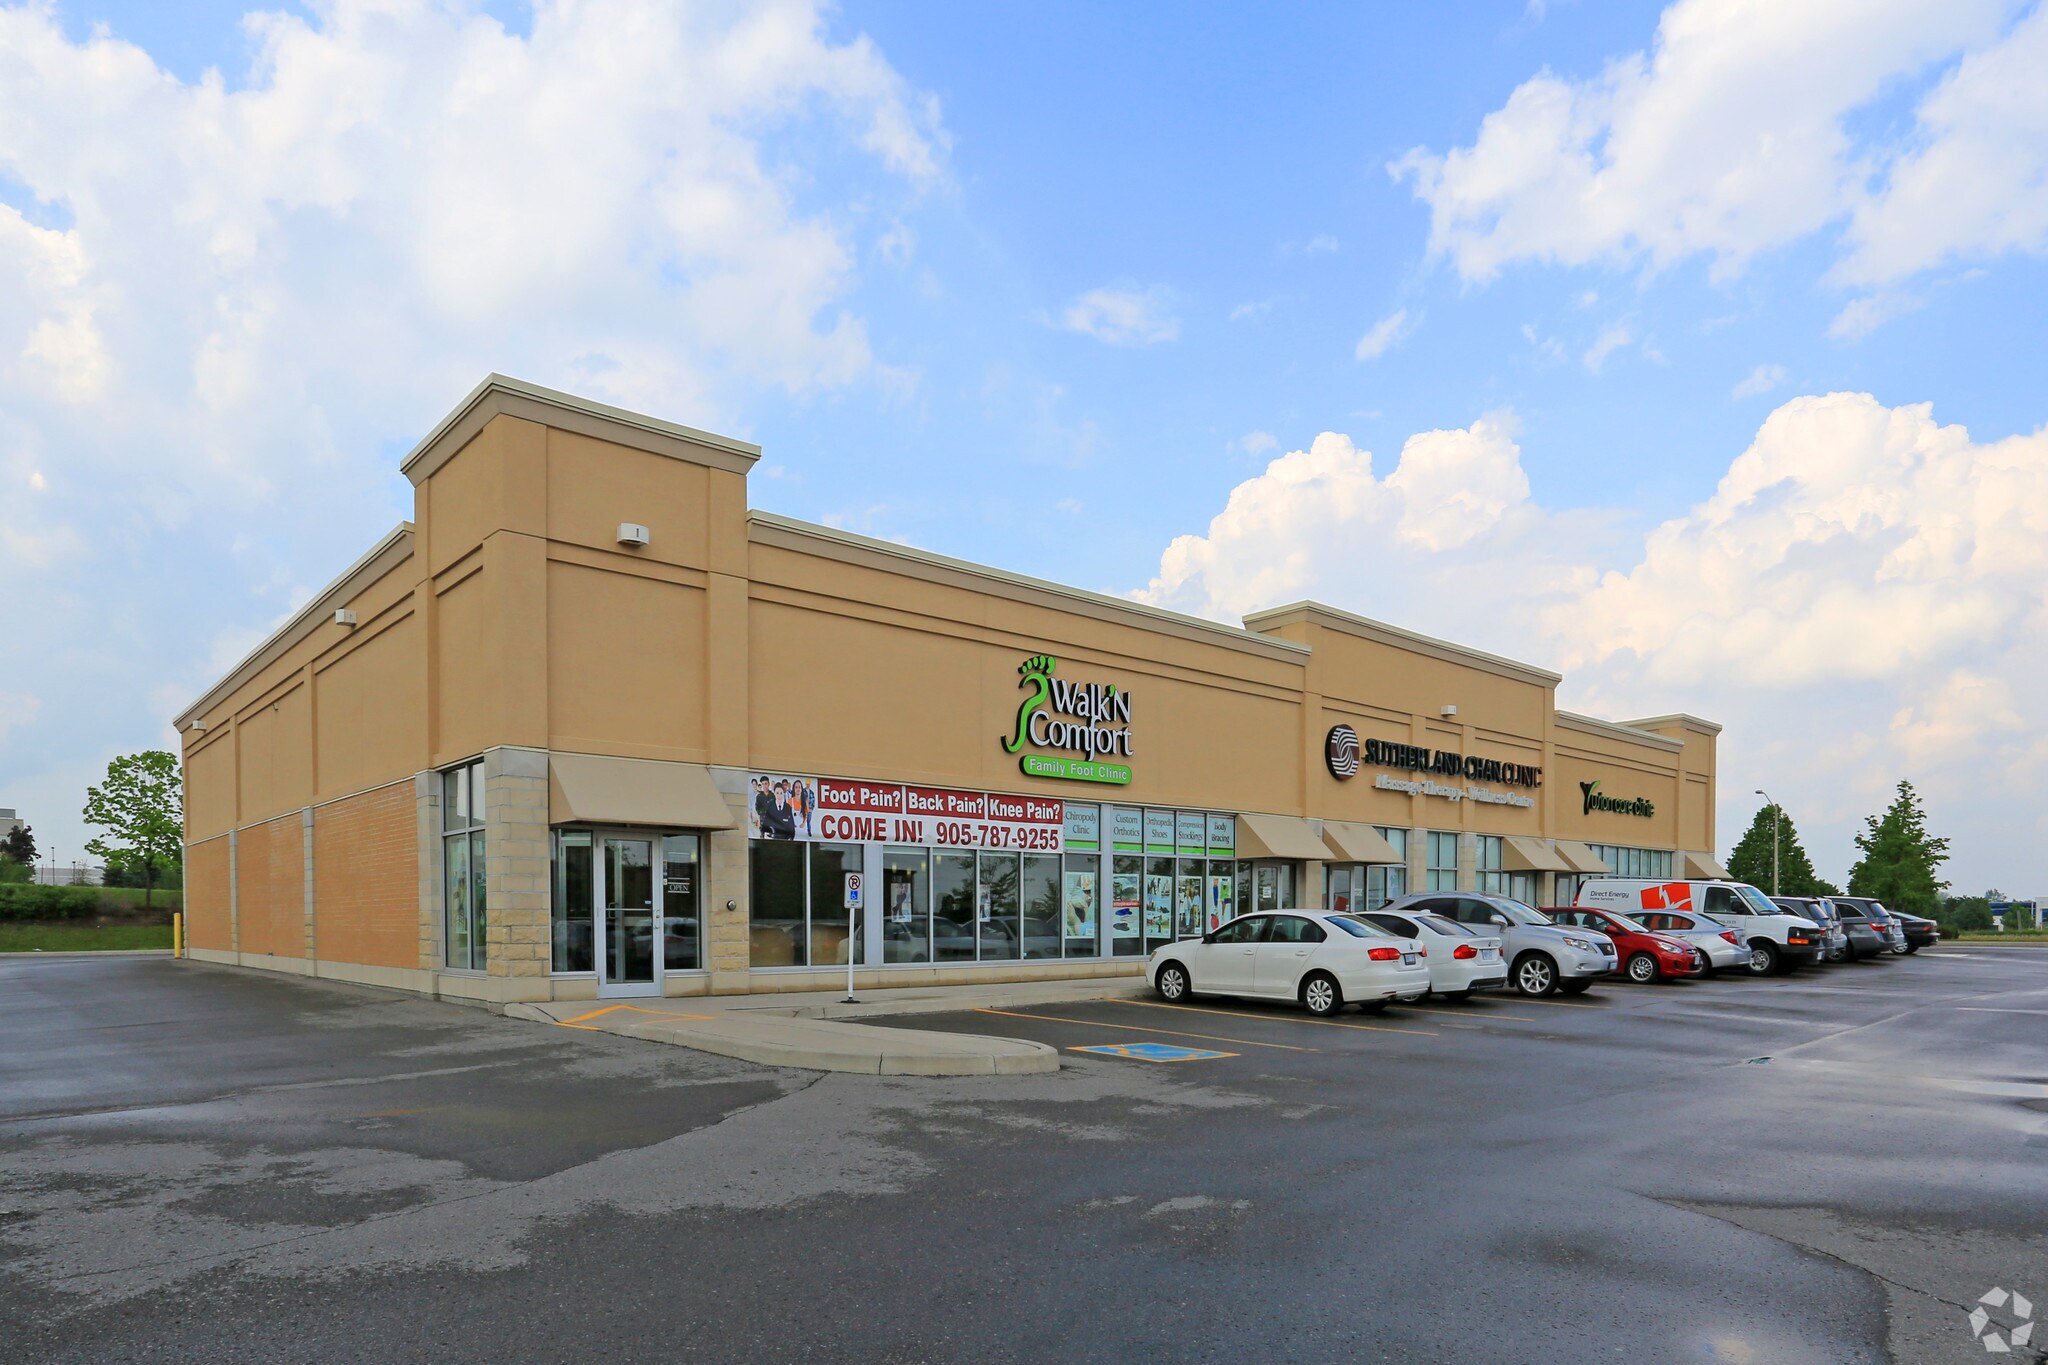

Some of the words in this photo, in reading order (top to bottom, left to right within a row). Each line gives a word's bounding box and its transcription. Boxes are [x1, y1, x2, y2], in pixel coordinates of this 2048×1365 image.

[1027, 709, 1134, 762] Comfort
[1029, 758, 1065, 776] Family
[1070, 763, 1094, 777] Foot
[1098, 766, 1127, 780] Clinic
[1502, 762, 1542, 788] CLINIC
[821, 784, 855, 805] Foot
[860, 787, 901, 808] Pain?
[908, 792, 944, 812] Back
[948, 796, 984, 815] Pain?
[989, 799, 1023, 819] Knee
[1026, 802, 1061, 821] Pain?
[1065, 811, 1097, 824] Chiropody
[1115, 814, 1138, 824] Custom
[821, 815, 887, 841] COME
[894, 819, 923, 843] IN!
[936, 822, 1060, 850] 905-787-9255
[1072, 824, 1090, 834] Clinic
[1113, 826, 1140, 837] Orthotics
[1151, 829, 1168, 839] Shoes
[1211, 833, 1230, 844] Bracing
[1608, 890, 1630, 899] Energy
